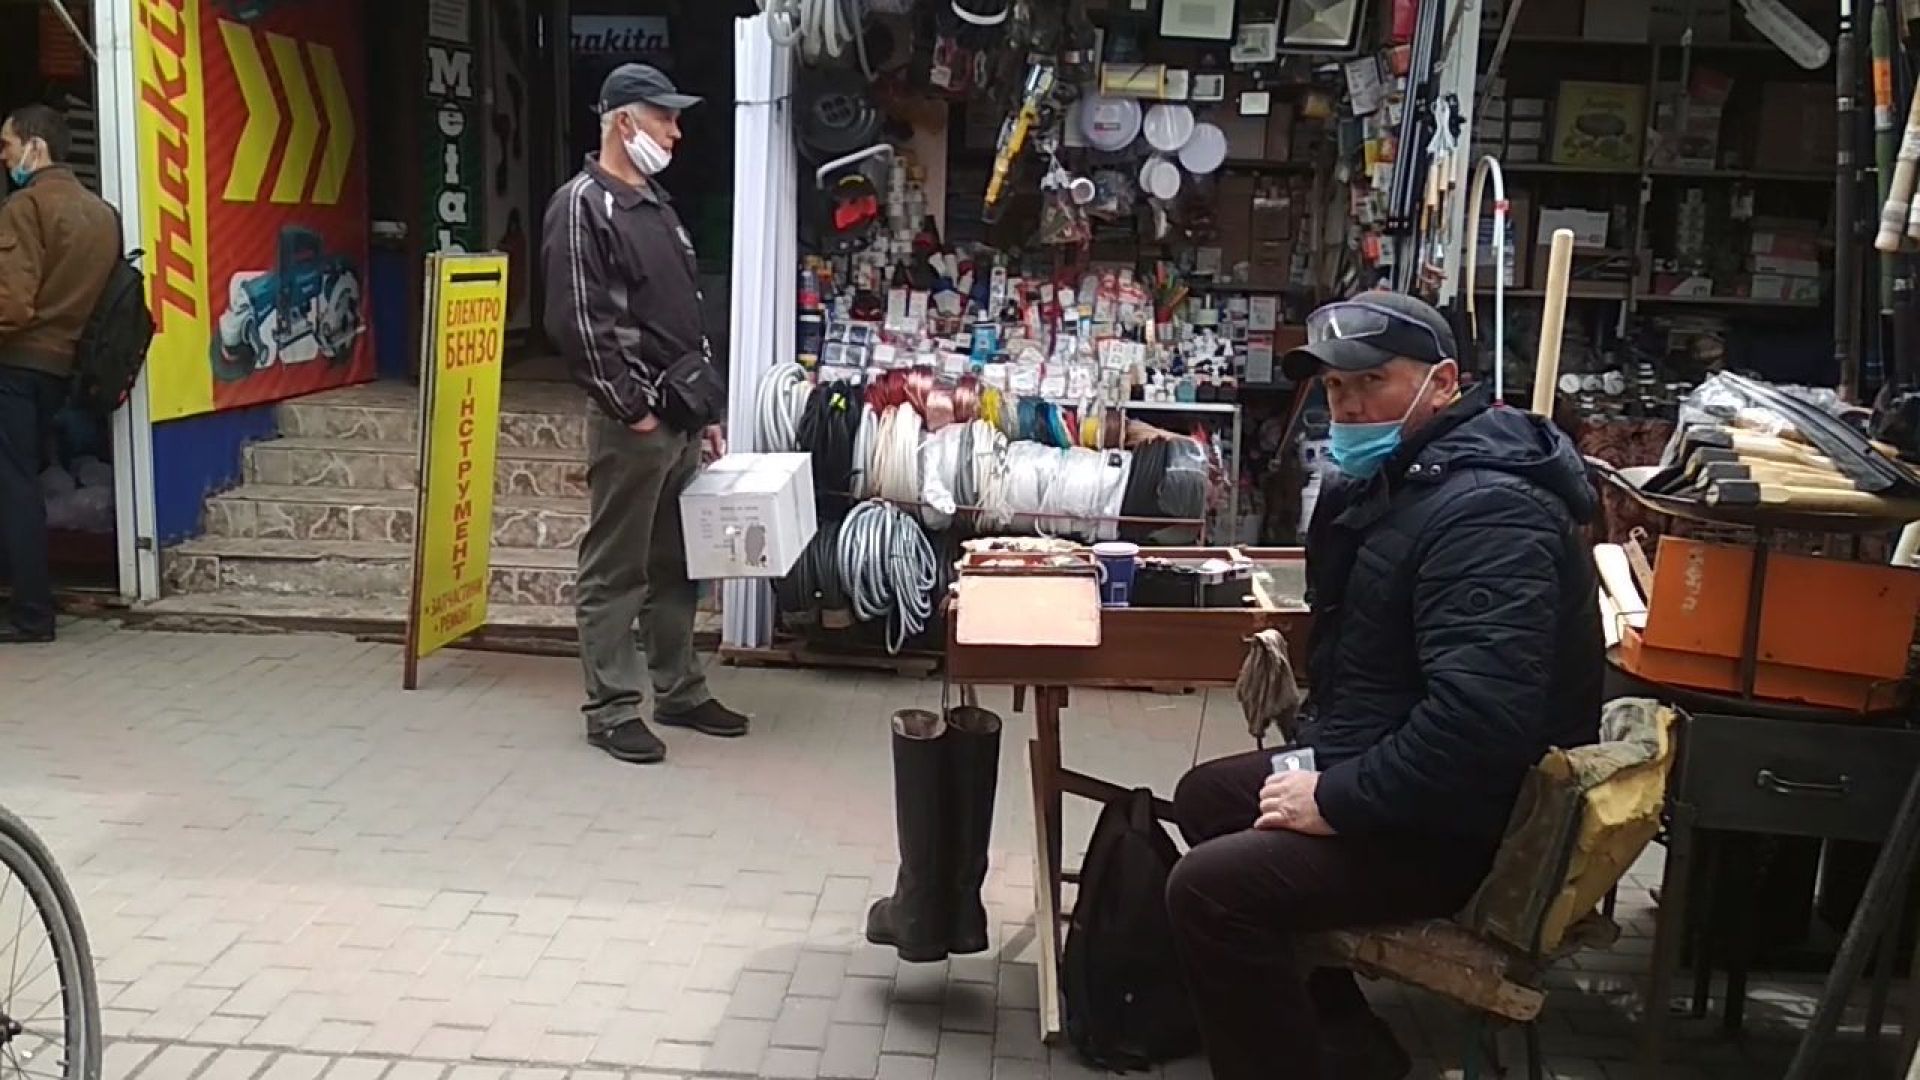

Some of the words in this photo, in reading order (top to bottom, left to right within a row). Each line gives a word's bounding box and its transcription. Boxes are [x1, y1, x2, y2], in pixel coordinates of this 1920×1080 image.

[139, 0, 197, 333] maki
[446, 297, 500, 327] ЕЛЕКТРО
[446, 327, 498, 370] БЕНЗО
[453, 377, 475, 580] ІНСТРУМЕНТ
